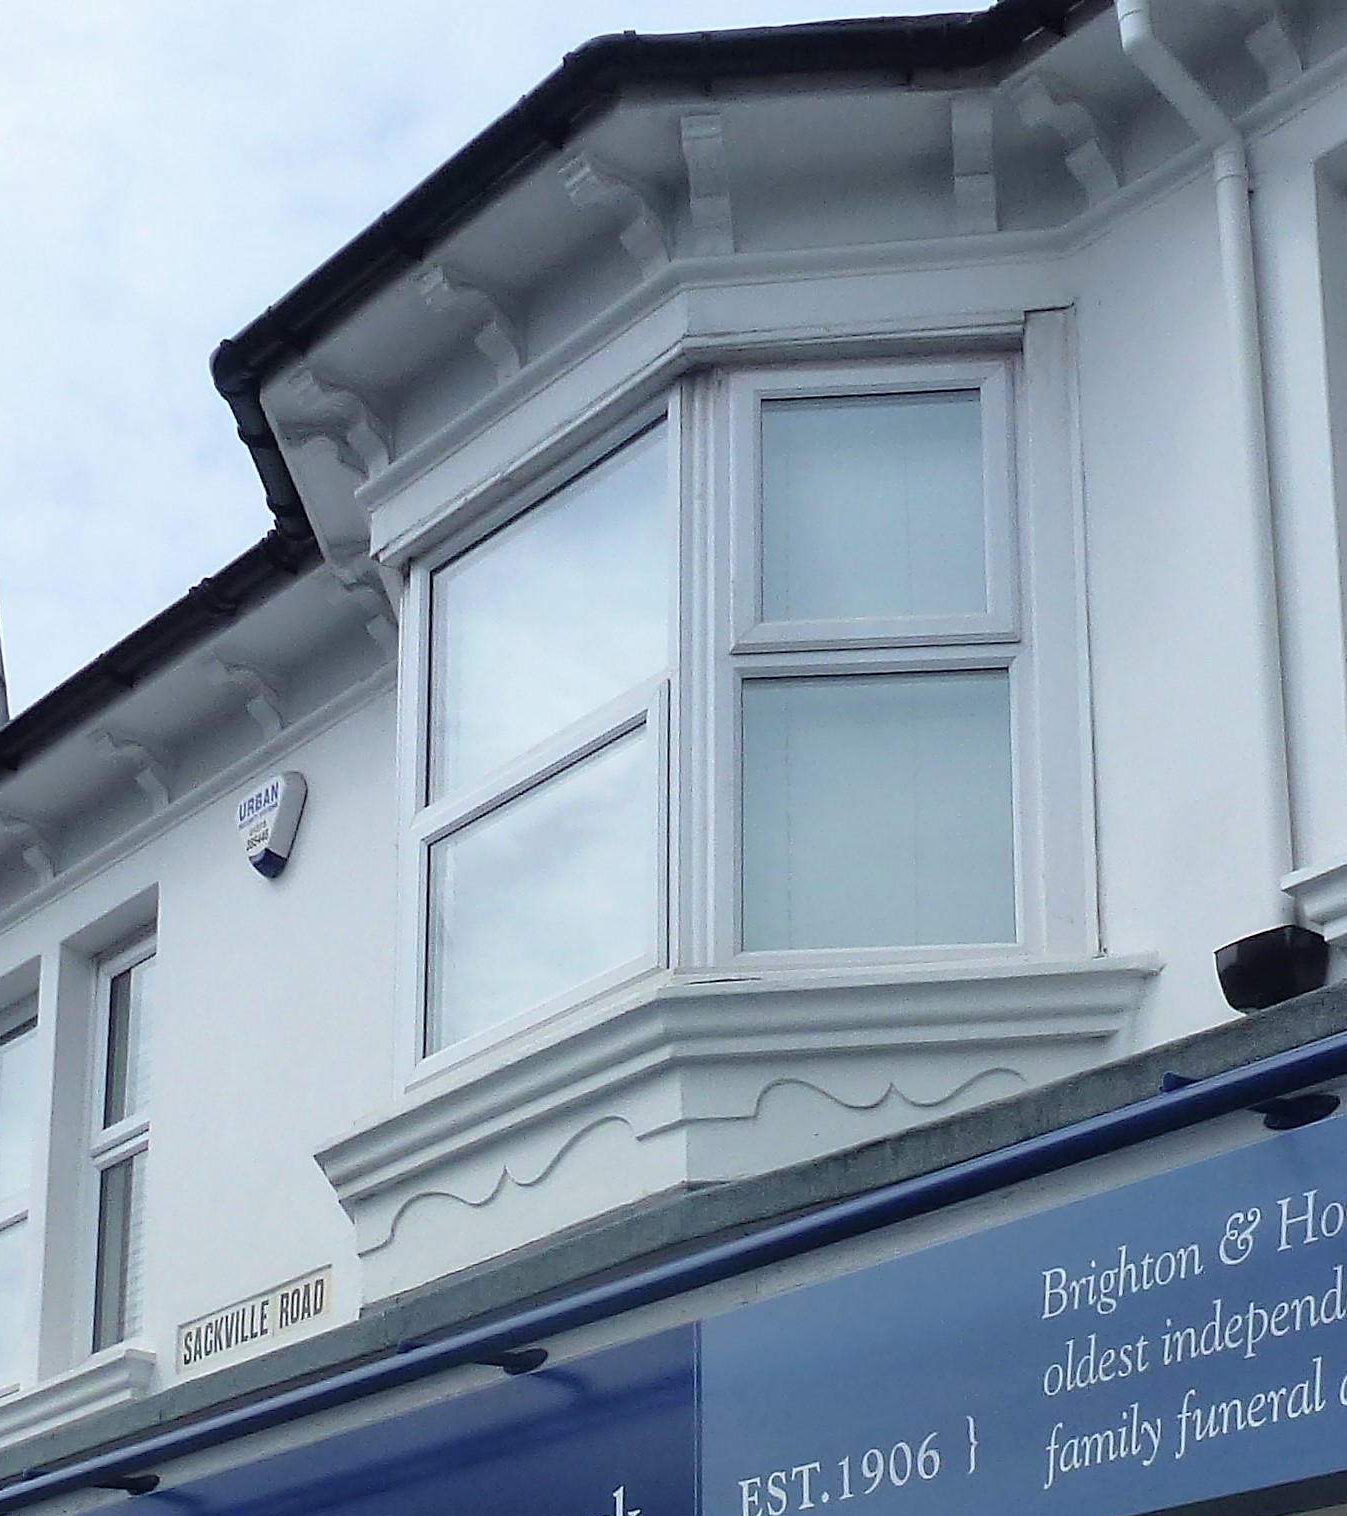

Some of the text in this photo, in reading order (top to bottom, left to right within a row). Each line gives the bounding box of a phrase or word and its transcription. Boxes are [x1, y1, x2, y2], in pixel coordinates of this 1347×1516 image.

[238, 781, 279, 822] URBAN
[1041, 1244, 1203, 1319] Brighton
[1219, 1207, 1261, 1266] &
[183, 1278, 325, 1366] SACKVILLE ROAD
[1043, 1333, 1150, 1396] oldest
[1043, 1402, 1162, 1490] family
[1174, 1356, 1326, 1460] funeral
